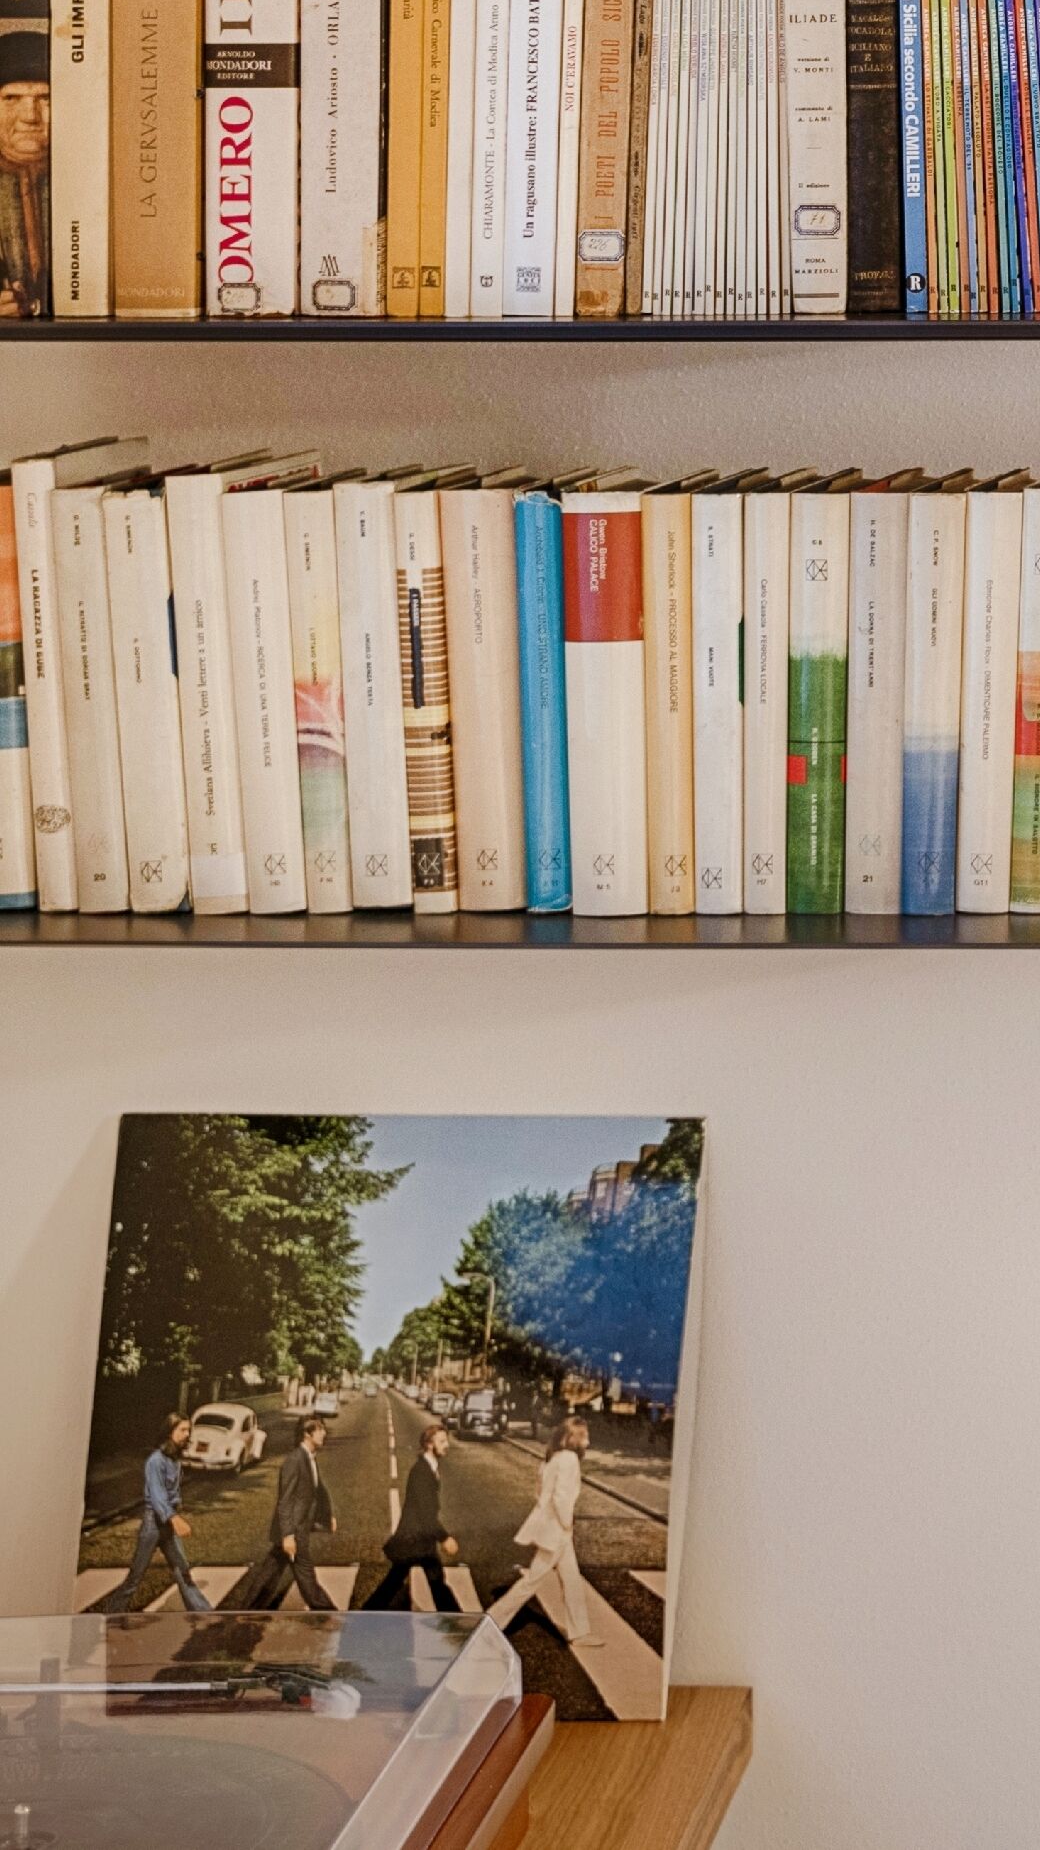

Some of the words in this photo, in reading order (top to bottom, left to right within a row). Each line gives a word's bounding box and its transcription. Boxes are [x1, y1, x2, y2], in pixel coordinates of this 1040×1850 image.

[489, 4, 499, 30] Anno
[789, 14, 838, 24] ILIADE
[903, 3, 917, 45] Sicilia
[72, 37, 85, 64] GLI
[430, 18, 442, 69] Carnevale
[488, 34, 499, 67] Modica
[565, 25, 577, 88] C'ERAVAMO
[206, 59, 273, 71] MONDADORI
[217, 72, 255, 80] EDITORE
[432, 74, 441, 84] di
[486, 74, 497, 84] di
[526, 26, 540, 112] FRANCESCO
[599, 39, 621, 93] POPOLO
[903, 47, 915, 112] secondo
[139, 7, 160, 183] GERVSALEMME
[326, 67, 339, 119] Ariosto
[428, 89, 441, 128] Modica
[486, 89, 496, 128] Contea
[524, 115, 537, 161] illustre:
[598, 110, 618, 138] DEL
[325, 128, 338, 194] Ludovico
[595, 155, 616, 198] POETI
[905, 115, 920, 198] CAMILLERI
[140, 199, 157, 219] LA
[217, 95, 254, 284] OMERO
[482, 151, 495, 240] CHIARAMONTE
[523, 164, 537, 221] ragusano
[522, 221, 533, 238] Un
[71, 220, 80, 301] MONDADORI
[910, 275, 921, 290] R
[589, 519, 598, 553] CALICO
[599, 519, 607, 545] Gwen
[31, 569, 39, 583] LA
[590, 556, 599, 593] PALACE
[33, 585, 42, 635] RAGAZZA
[473, 588, 483, 644] AEROPORTO
[668, 598, 678, 648] PROCESSO
[669, 650, 677, 662] AL
[669, 664, 678, 713] MAGGIORE
[862, 874, 874, 883] 21
